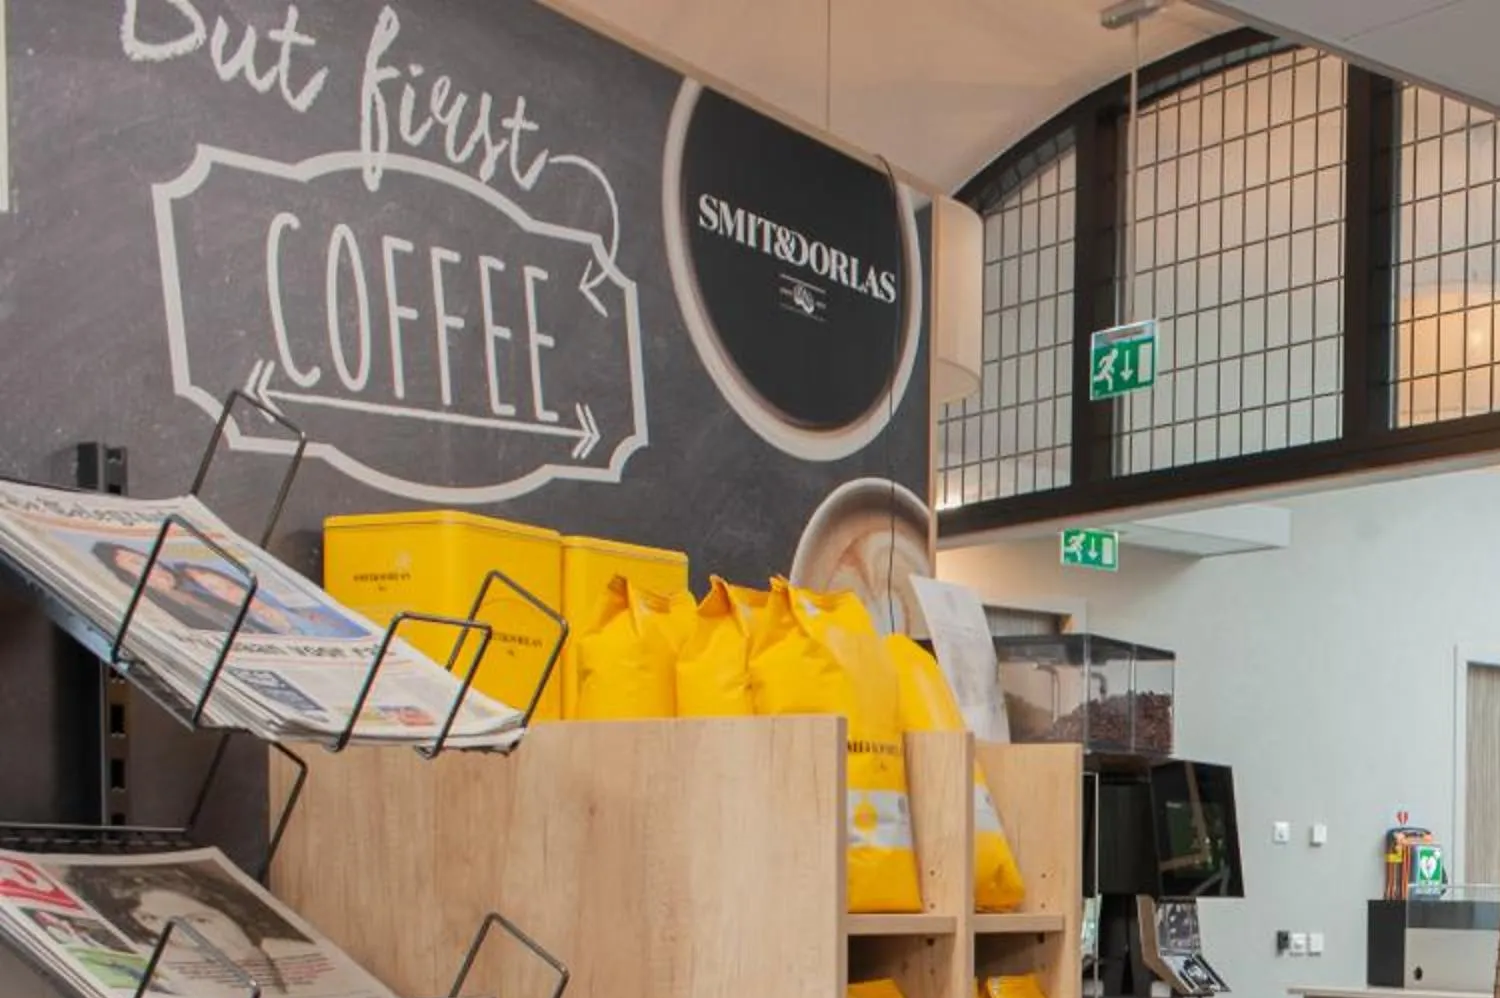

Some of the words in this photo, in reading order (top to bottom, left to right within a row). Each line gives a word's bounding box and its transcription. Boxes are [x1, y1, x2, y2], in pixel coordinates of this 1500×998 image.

[360, 4, 549, 191] first
[266, 211, 559, 423] COFFEE
[698, 193, 897, 304] SMIT&DORLAS
